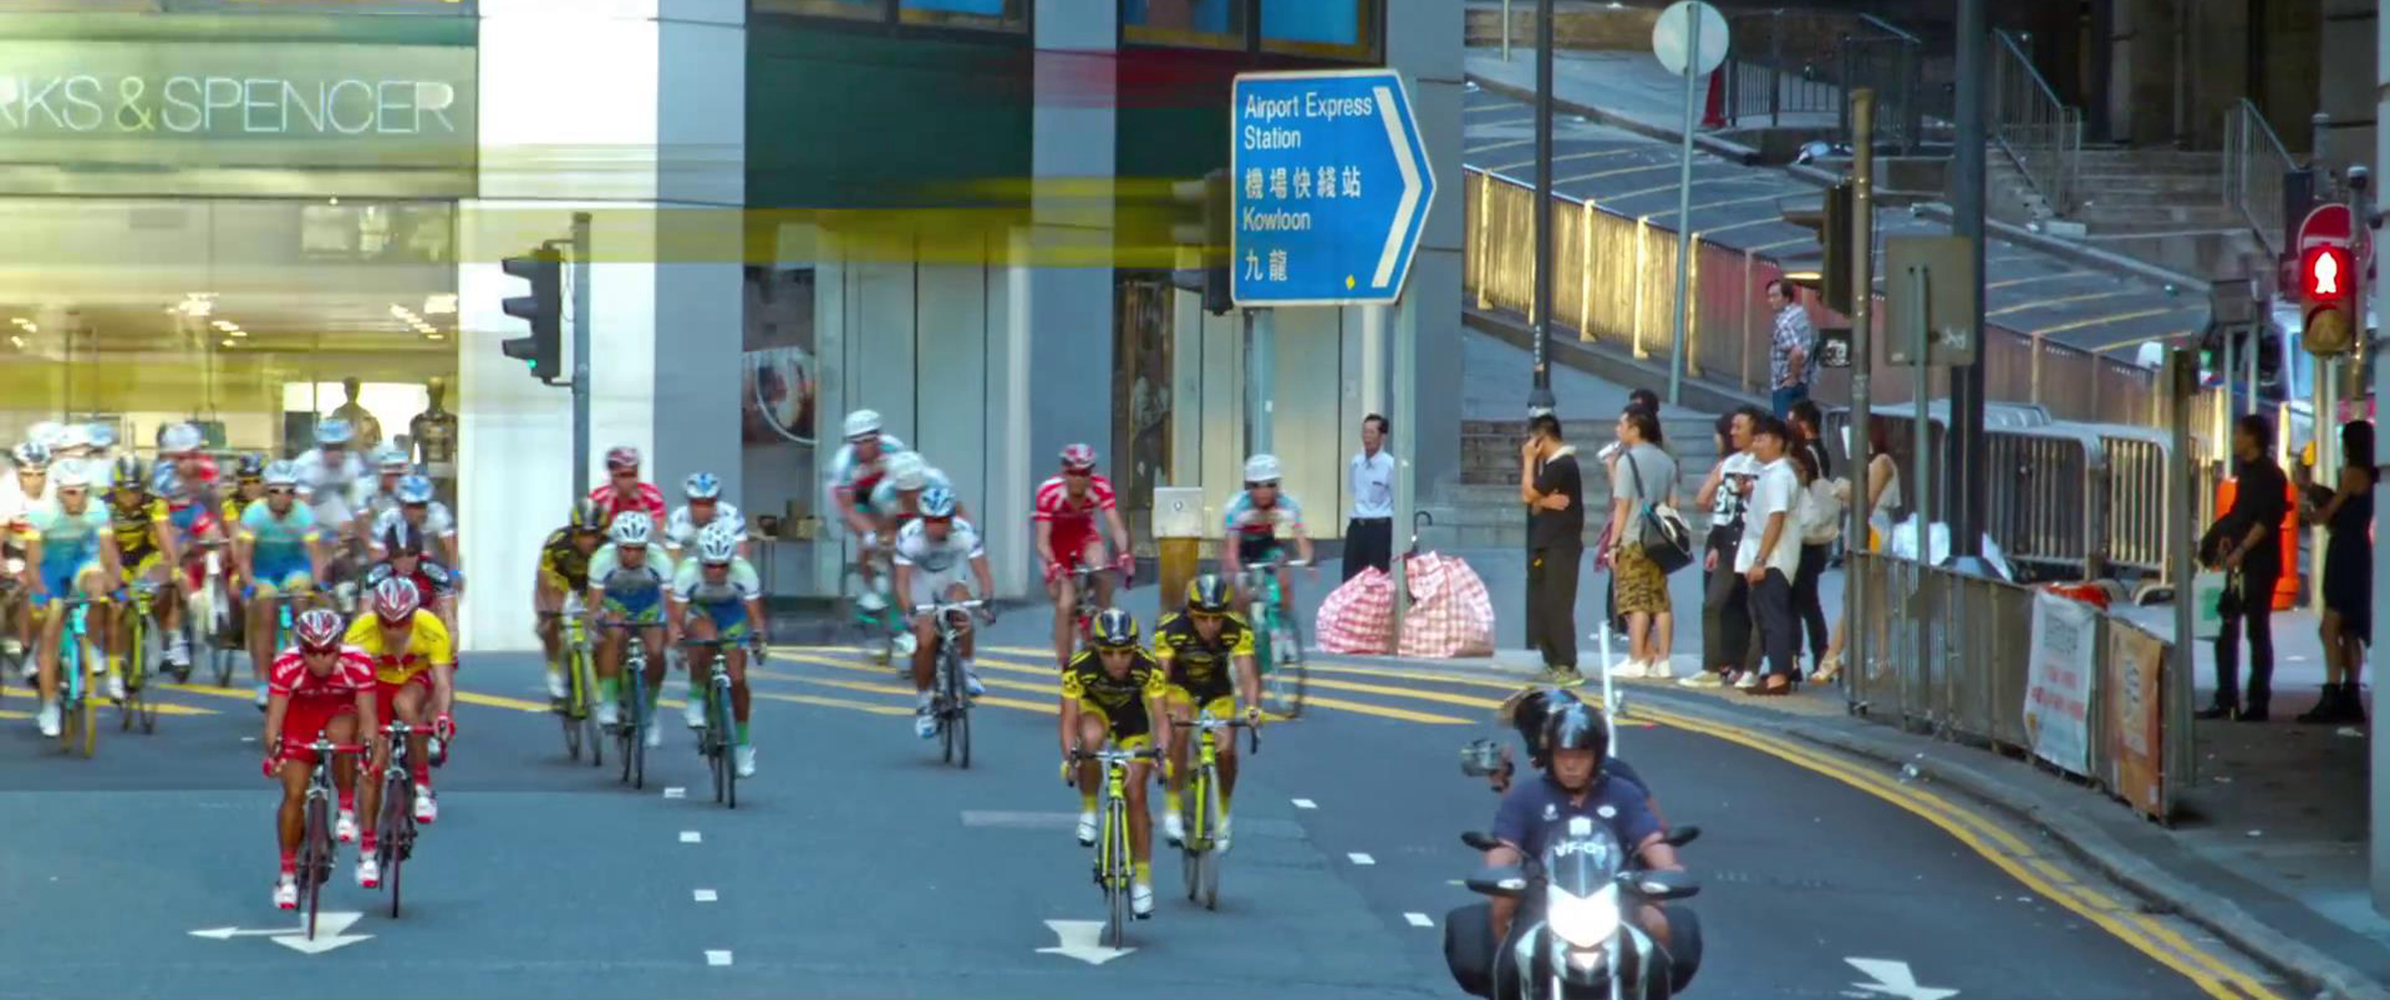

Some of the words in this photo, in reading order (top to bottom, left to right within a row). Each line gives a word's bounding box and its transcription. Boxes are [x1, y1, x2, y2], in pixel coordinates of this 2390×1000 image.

[115, 75, 155, 132] &
[162, 76, 454, 133] SPENCER
[1244, 94, 1299, 123] Airport
[1306, 92, 1373, 121] Express
[1244, 125, 1301, 150] Station
[1243, 206, 1311, 232] Kowloon
[1244, 248, 1288, 282] 九龍
